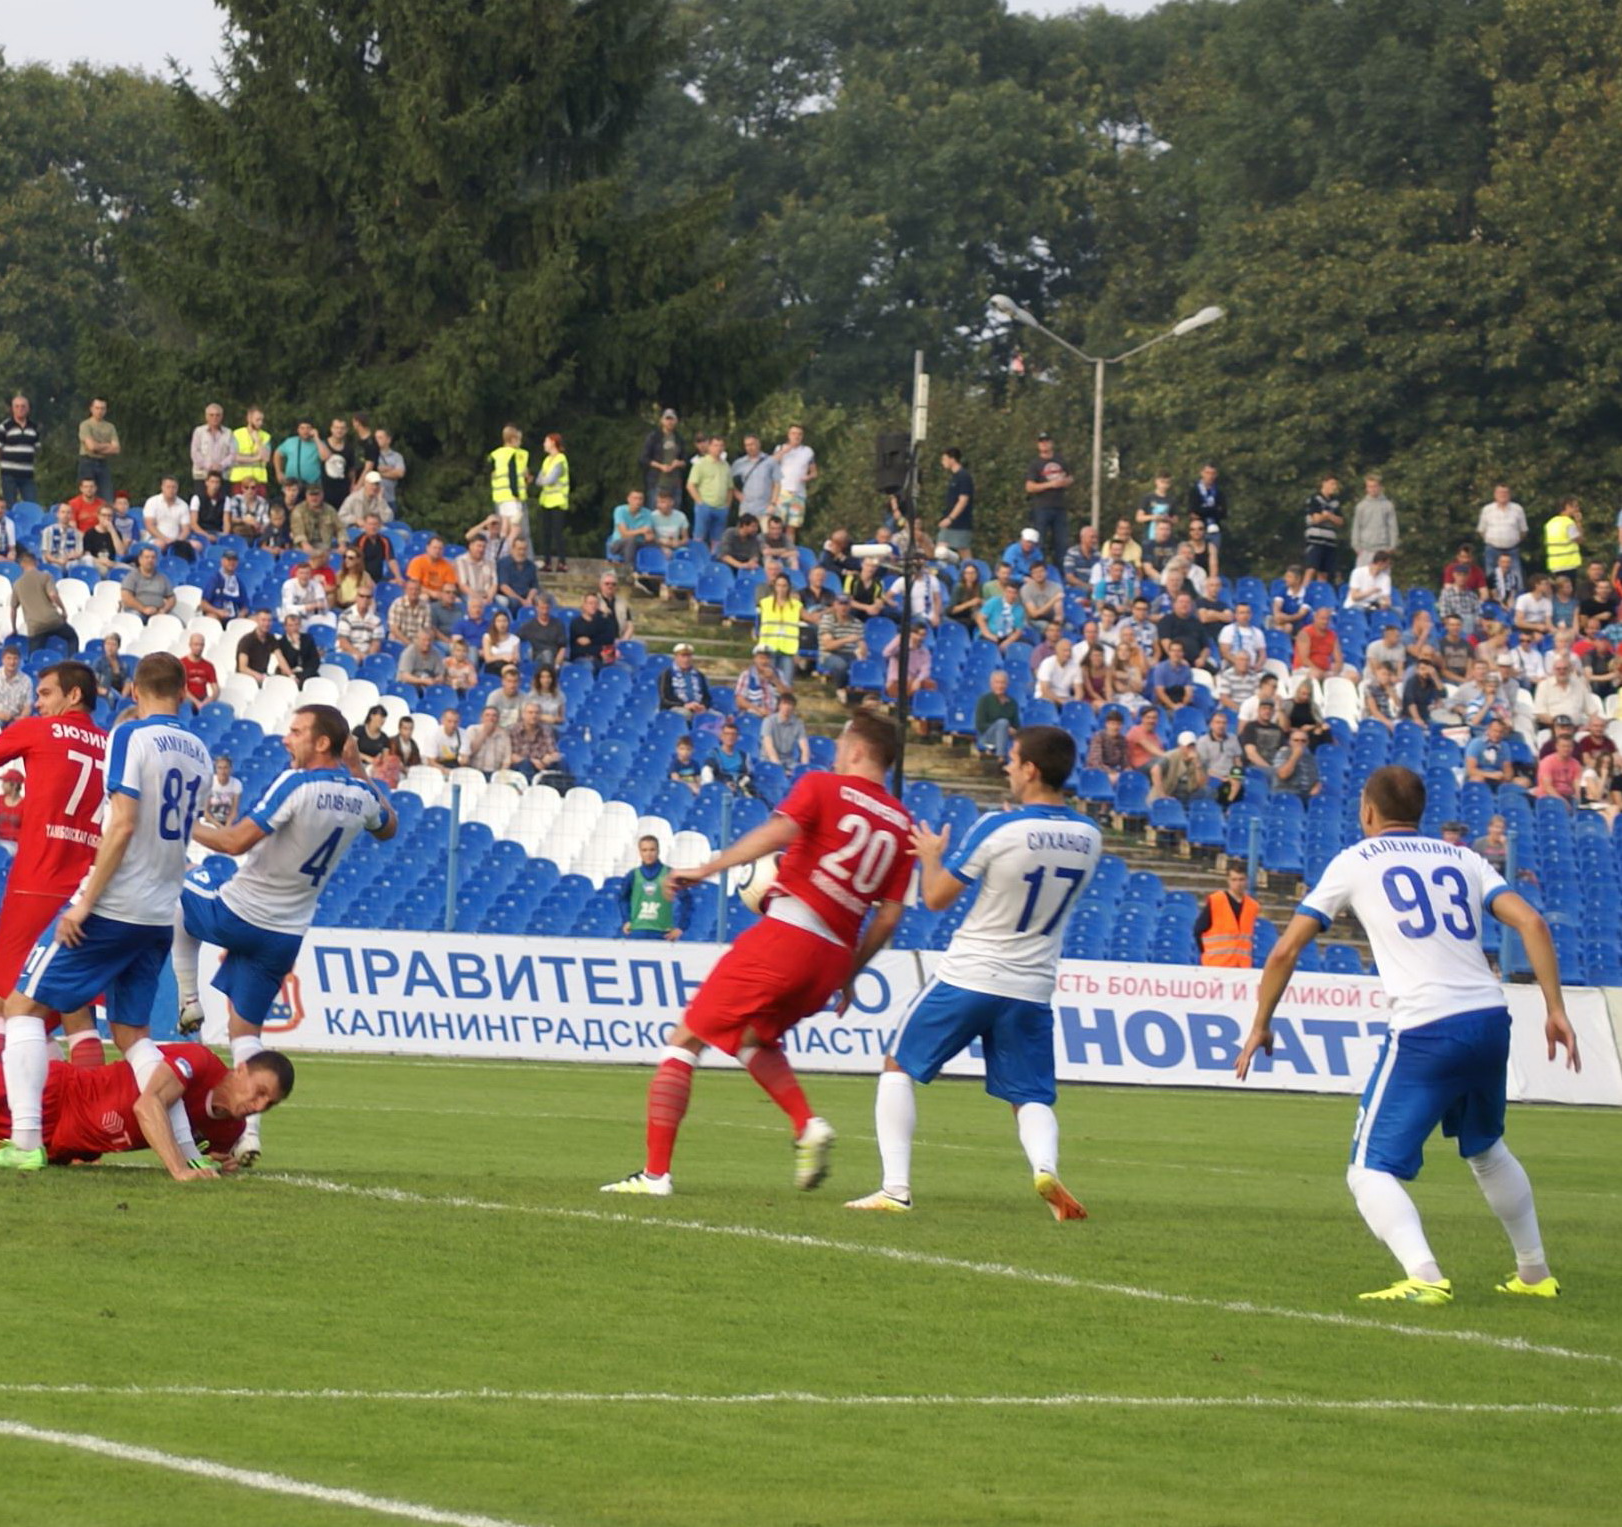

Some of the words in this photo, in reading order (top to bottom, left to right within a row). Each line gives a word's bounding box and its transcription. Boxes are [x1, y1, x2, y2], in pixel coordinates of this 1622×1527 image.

[51, 722, 110, 750] ЗЮЗИН
[159, 768, 202, 845] 81
[299, 827, 344, 887] 4
[818, 814, 898, 894] 20
[1358, 839, 1462, 861] КАЛЕНКОВИЧ
[1015, 865, 1086, 936] 17
[1382, 866, 1477, 940] 93
[314, 945, 891, 1014] ПРАВИТЕЛЬО
[1108, 975, 1224, 1000] БОЛЬШОЙ
[1233, 984, 1248, 1001] И
[1256, 985, 1362, 1008] ЛИКОЙ
[324, 1007, 690, 1050] КАЛИНИНГРАДСК
[778, 1024, 898, 1056] ЛАСТИ
